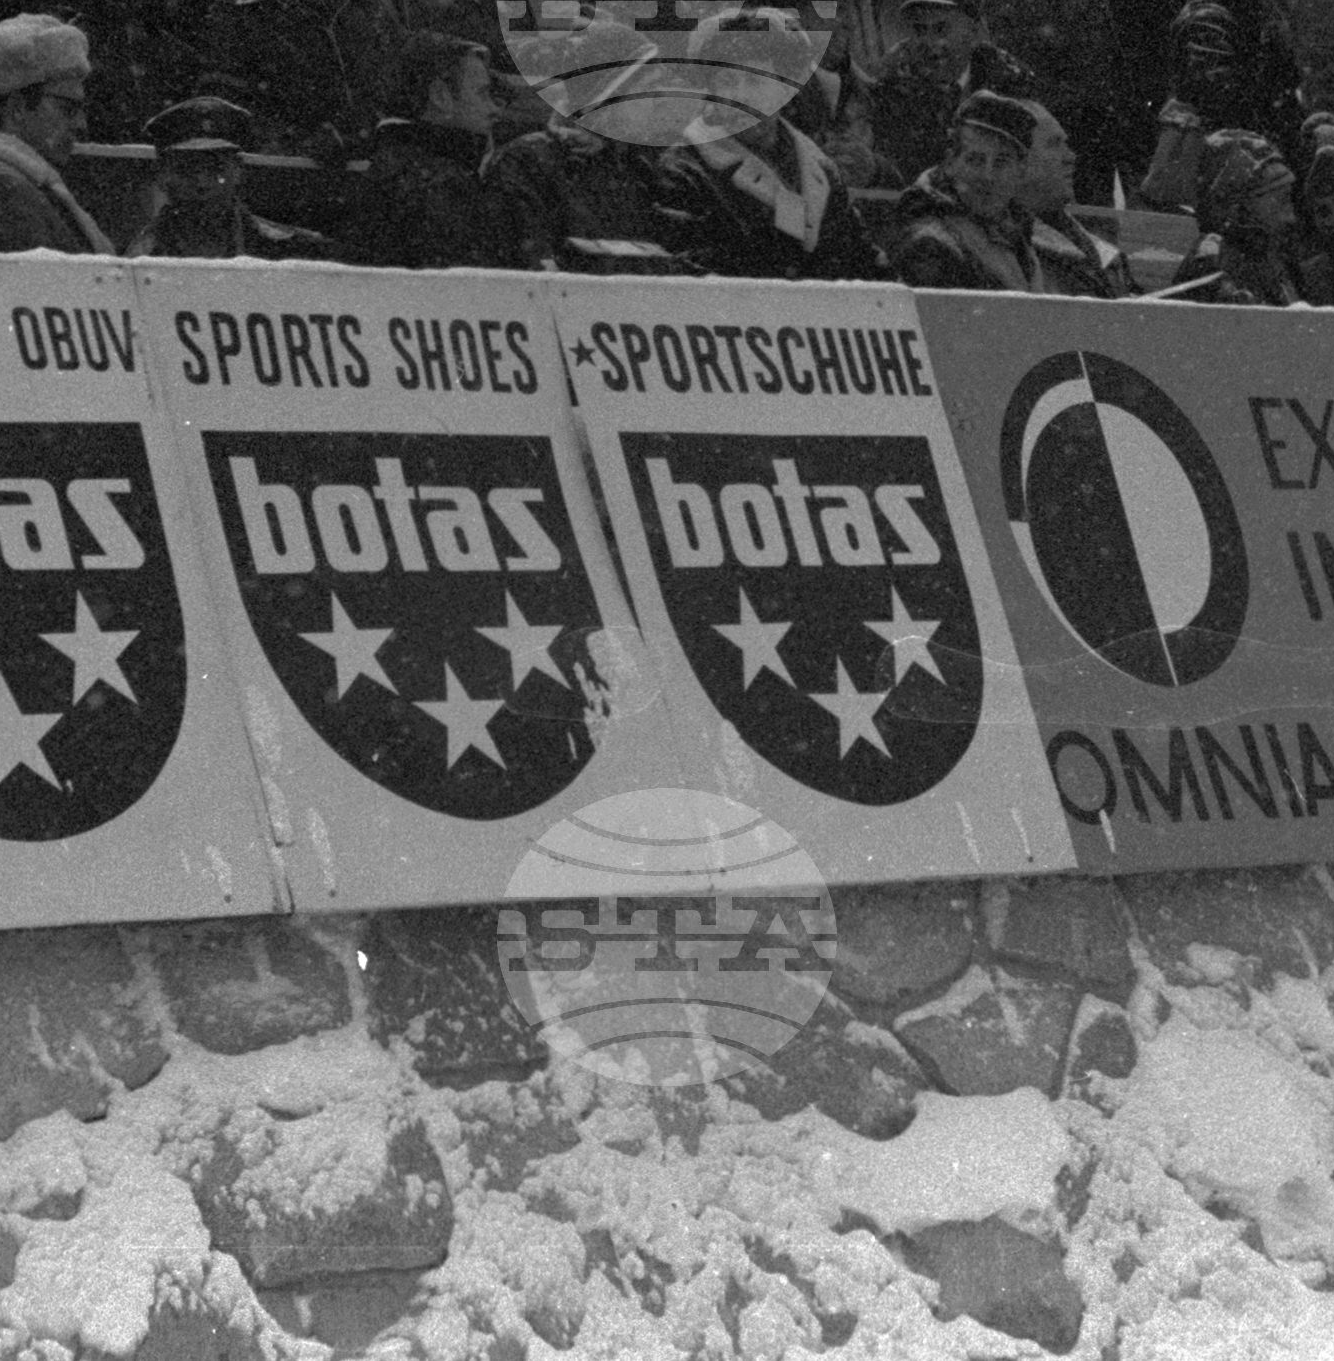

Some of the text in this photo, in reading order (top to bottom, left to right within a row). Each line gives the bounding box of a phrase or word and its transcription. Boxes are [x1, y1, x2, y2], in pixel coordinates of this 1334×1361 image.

[11, 306, 137, 372] OBUV
[174, 311, 539, 395] SPORTS SHOES
[590, 321, 933, 397] SPORTSCHUHE
[228, 456, 562, 574] botas
[645, 457, 941, 569] botas
